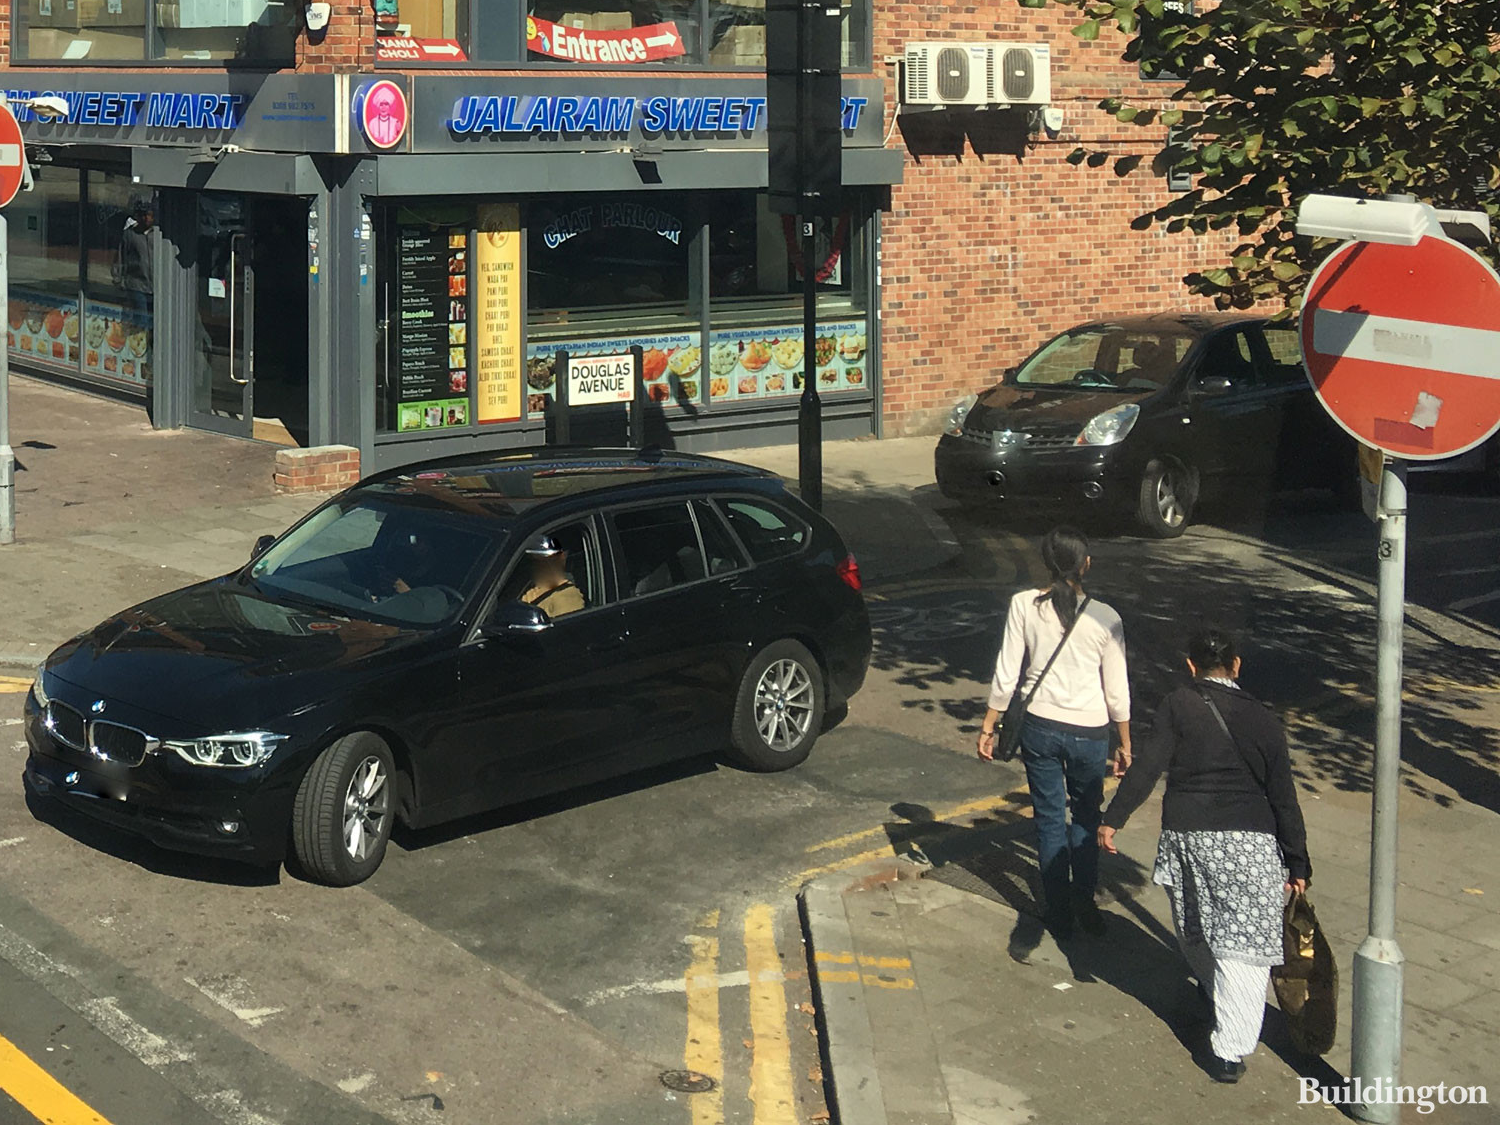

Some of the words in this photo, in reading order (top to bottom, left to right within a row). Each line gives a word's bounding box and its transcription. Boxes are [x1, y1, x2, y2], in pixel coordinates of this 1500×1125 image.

[552, 25, 647, 63] Entrance
[378, 49, 420, 59] CHOLI
[146, 93, 244, 130] MART
[452, 96, 636, 133] JALARAM
[644, 97, 768, 132] SWEET
[543, 206, 593, 249] CHAT
[601, 203, 682, 245] PARLOUR
[804, 224, 810, 235] 3
[402, 309, 434, 319] Smoothies
[572, 363, 630, 379] DOUGLAS
[578, 377, 625, 394] AVENUE
[1380, 541, 1393, 559] 3
